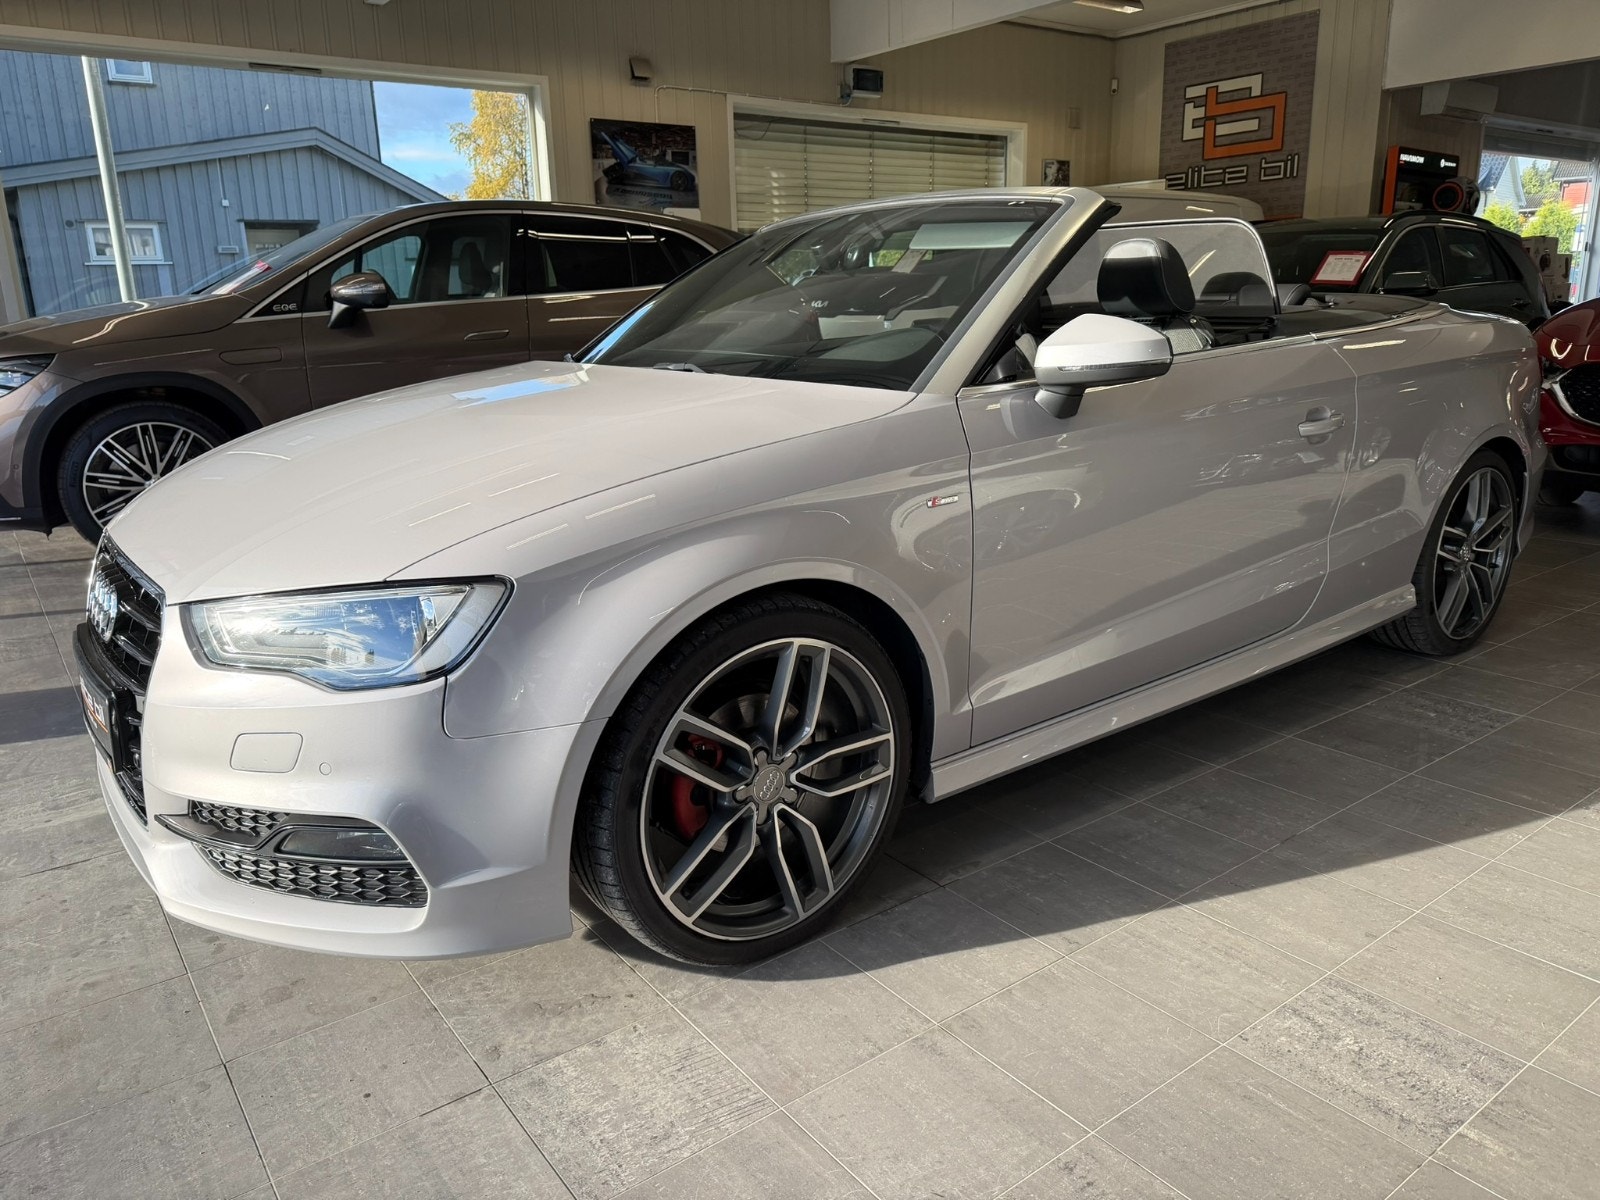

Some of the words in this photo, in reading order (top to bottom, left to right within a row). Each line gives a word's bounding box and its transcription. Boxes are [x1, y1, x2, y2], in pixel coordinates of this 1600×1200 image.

[1165, 165, 1248, 190] elite
[1260, 154, 1299, 181] bil
[272, 303, 298, 312] EQE
